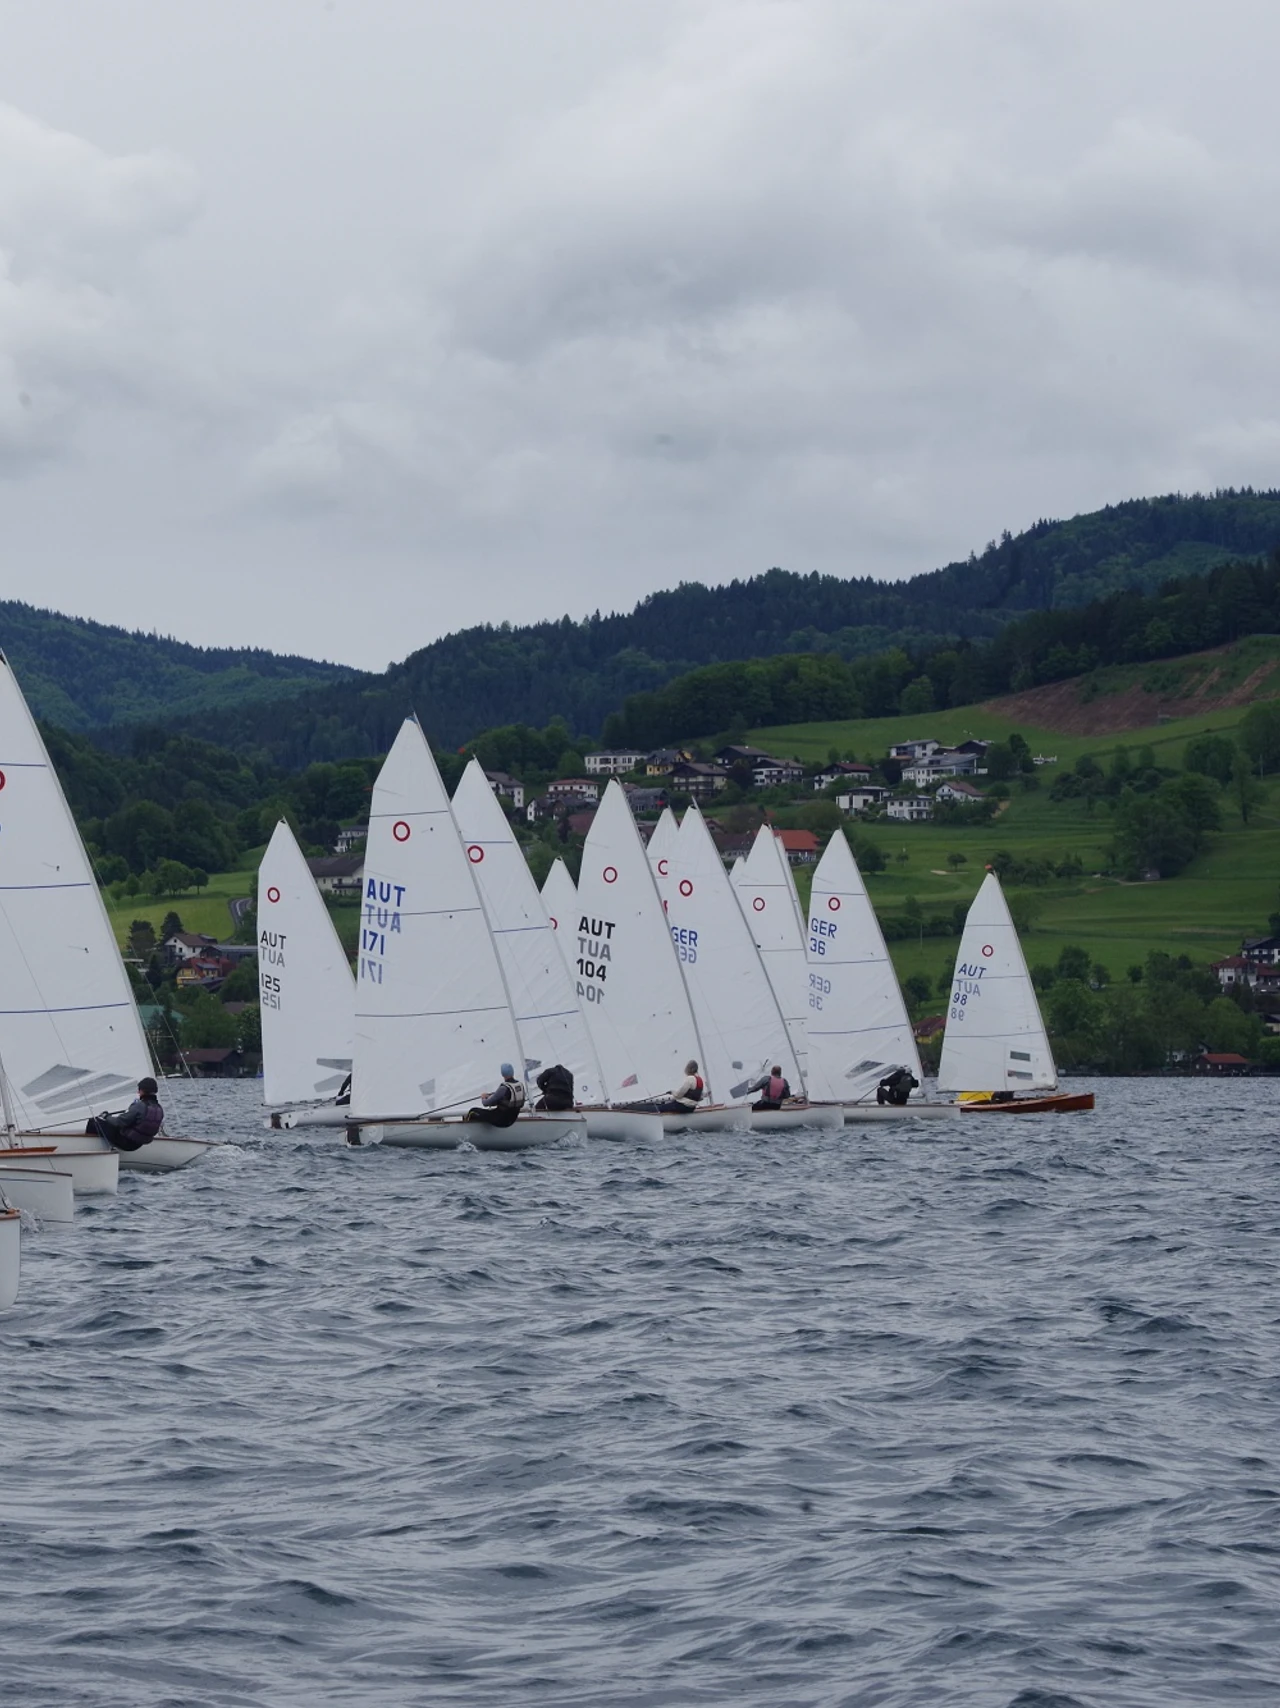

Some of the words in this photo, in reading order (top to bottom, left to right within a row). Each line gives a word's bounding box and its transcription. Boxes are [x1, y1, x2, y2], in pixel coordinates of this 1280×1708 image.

[366, 878, 406, 908] AUT
[578, 916, 616, 939] AUT
[810, 917, 838, 939] GER
[260, 930, 287, 949] AUT
[362, 929, 385, 955] 171
[809, 937, 826, 955] 36
[576, 958, 607, 982] 104
[958, 963, 987, 979] AUT
[261, 972, 280, 993] 125
[952, 992, 968, 1006] 98
